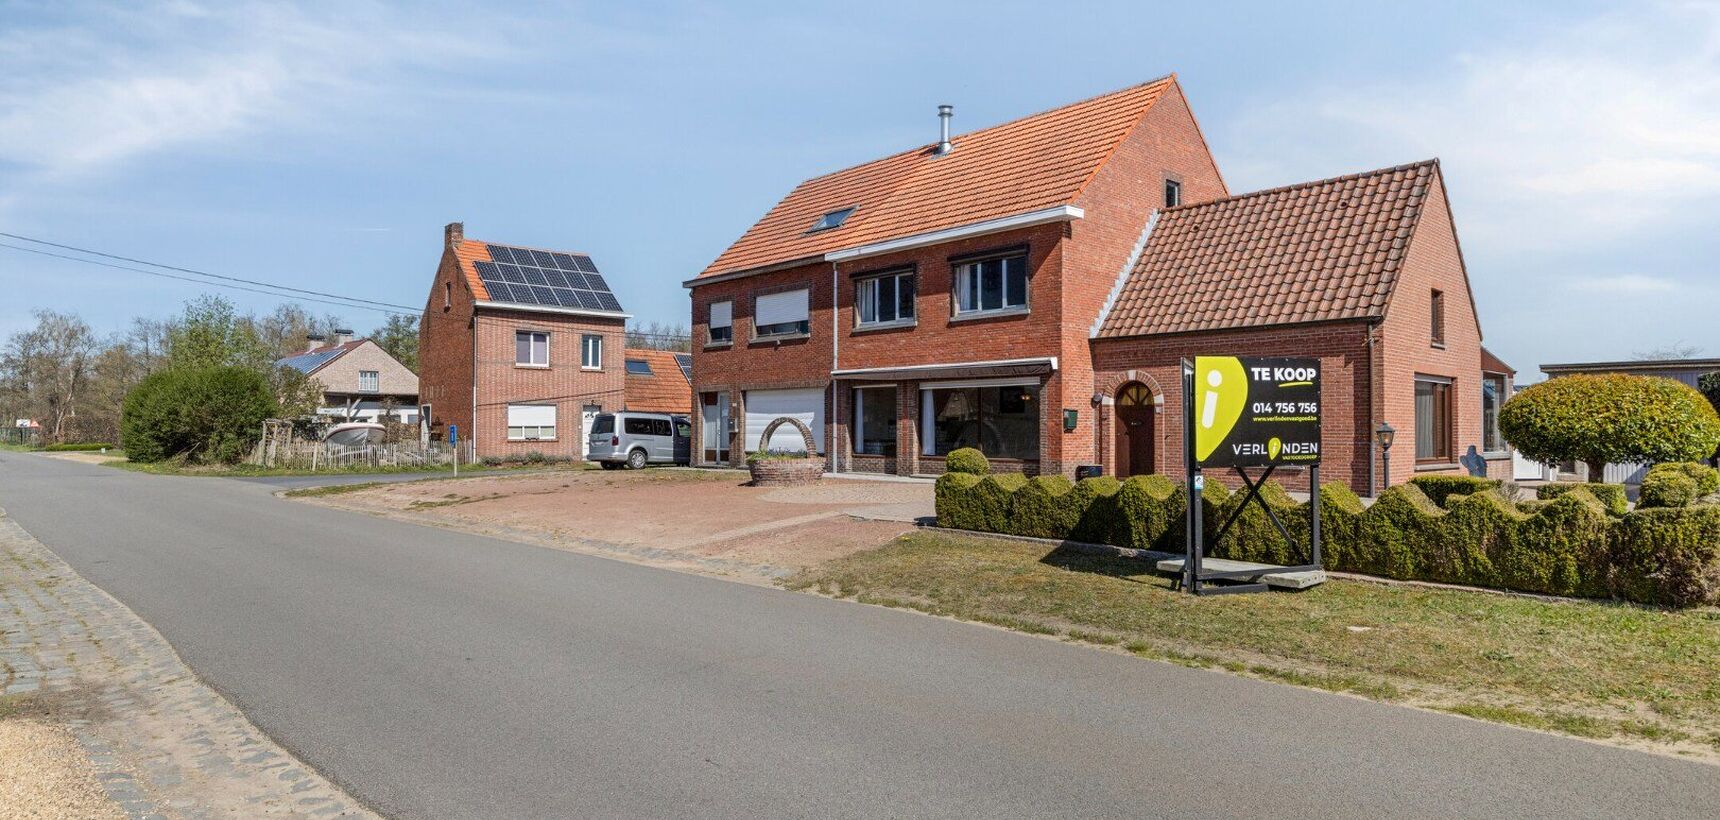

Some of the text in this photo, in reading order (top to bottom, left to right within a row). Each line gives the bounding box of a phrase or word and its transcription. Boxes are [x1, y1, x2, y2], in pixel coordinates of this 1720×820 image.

[1251, 367, 1316, 381] TE KOOP
[1253, 402, 1317, 413] 014 756 756
